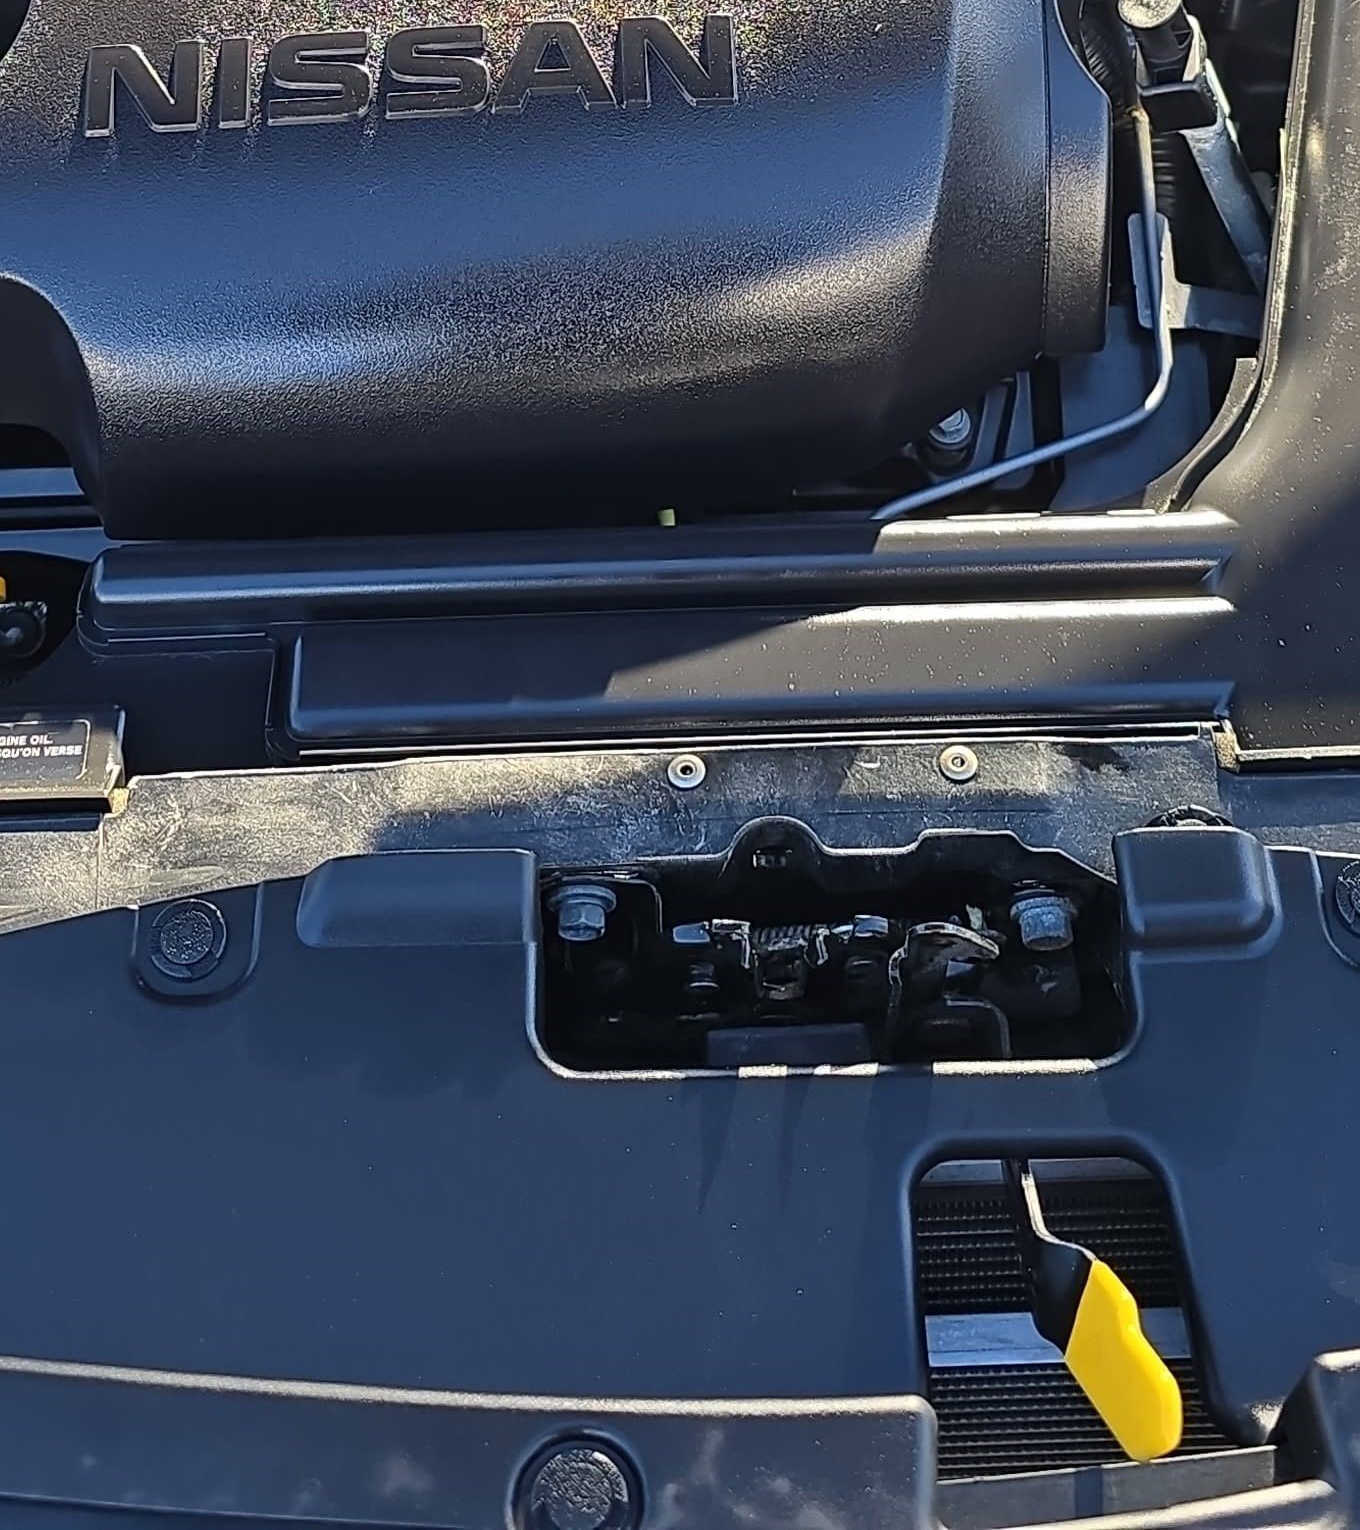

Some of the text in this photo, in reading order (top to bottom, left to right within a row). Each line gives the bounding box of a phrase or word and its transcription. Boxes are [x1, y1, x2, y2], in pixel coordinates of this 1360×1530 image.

[82, 13, 740, 139] NISSAN
[29, 734, 54, 745] OIL.
[42, 744, 83, 757] VERSE
